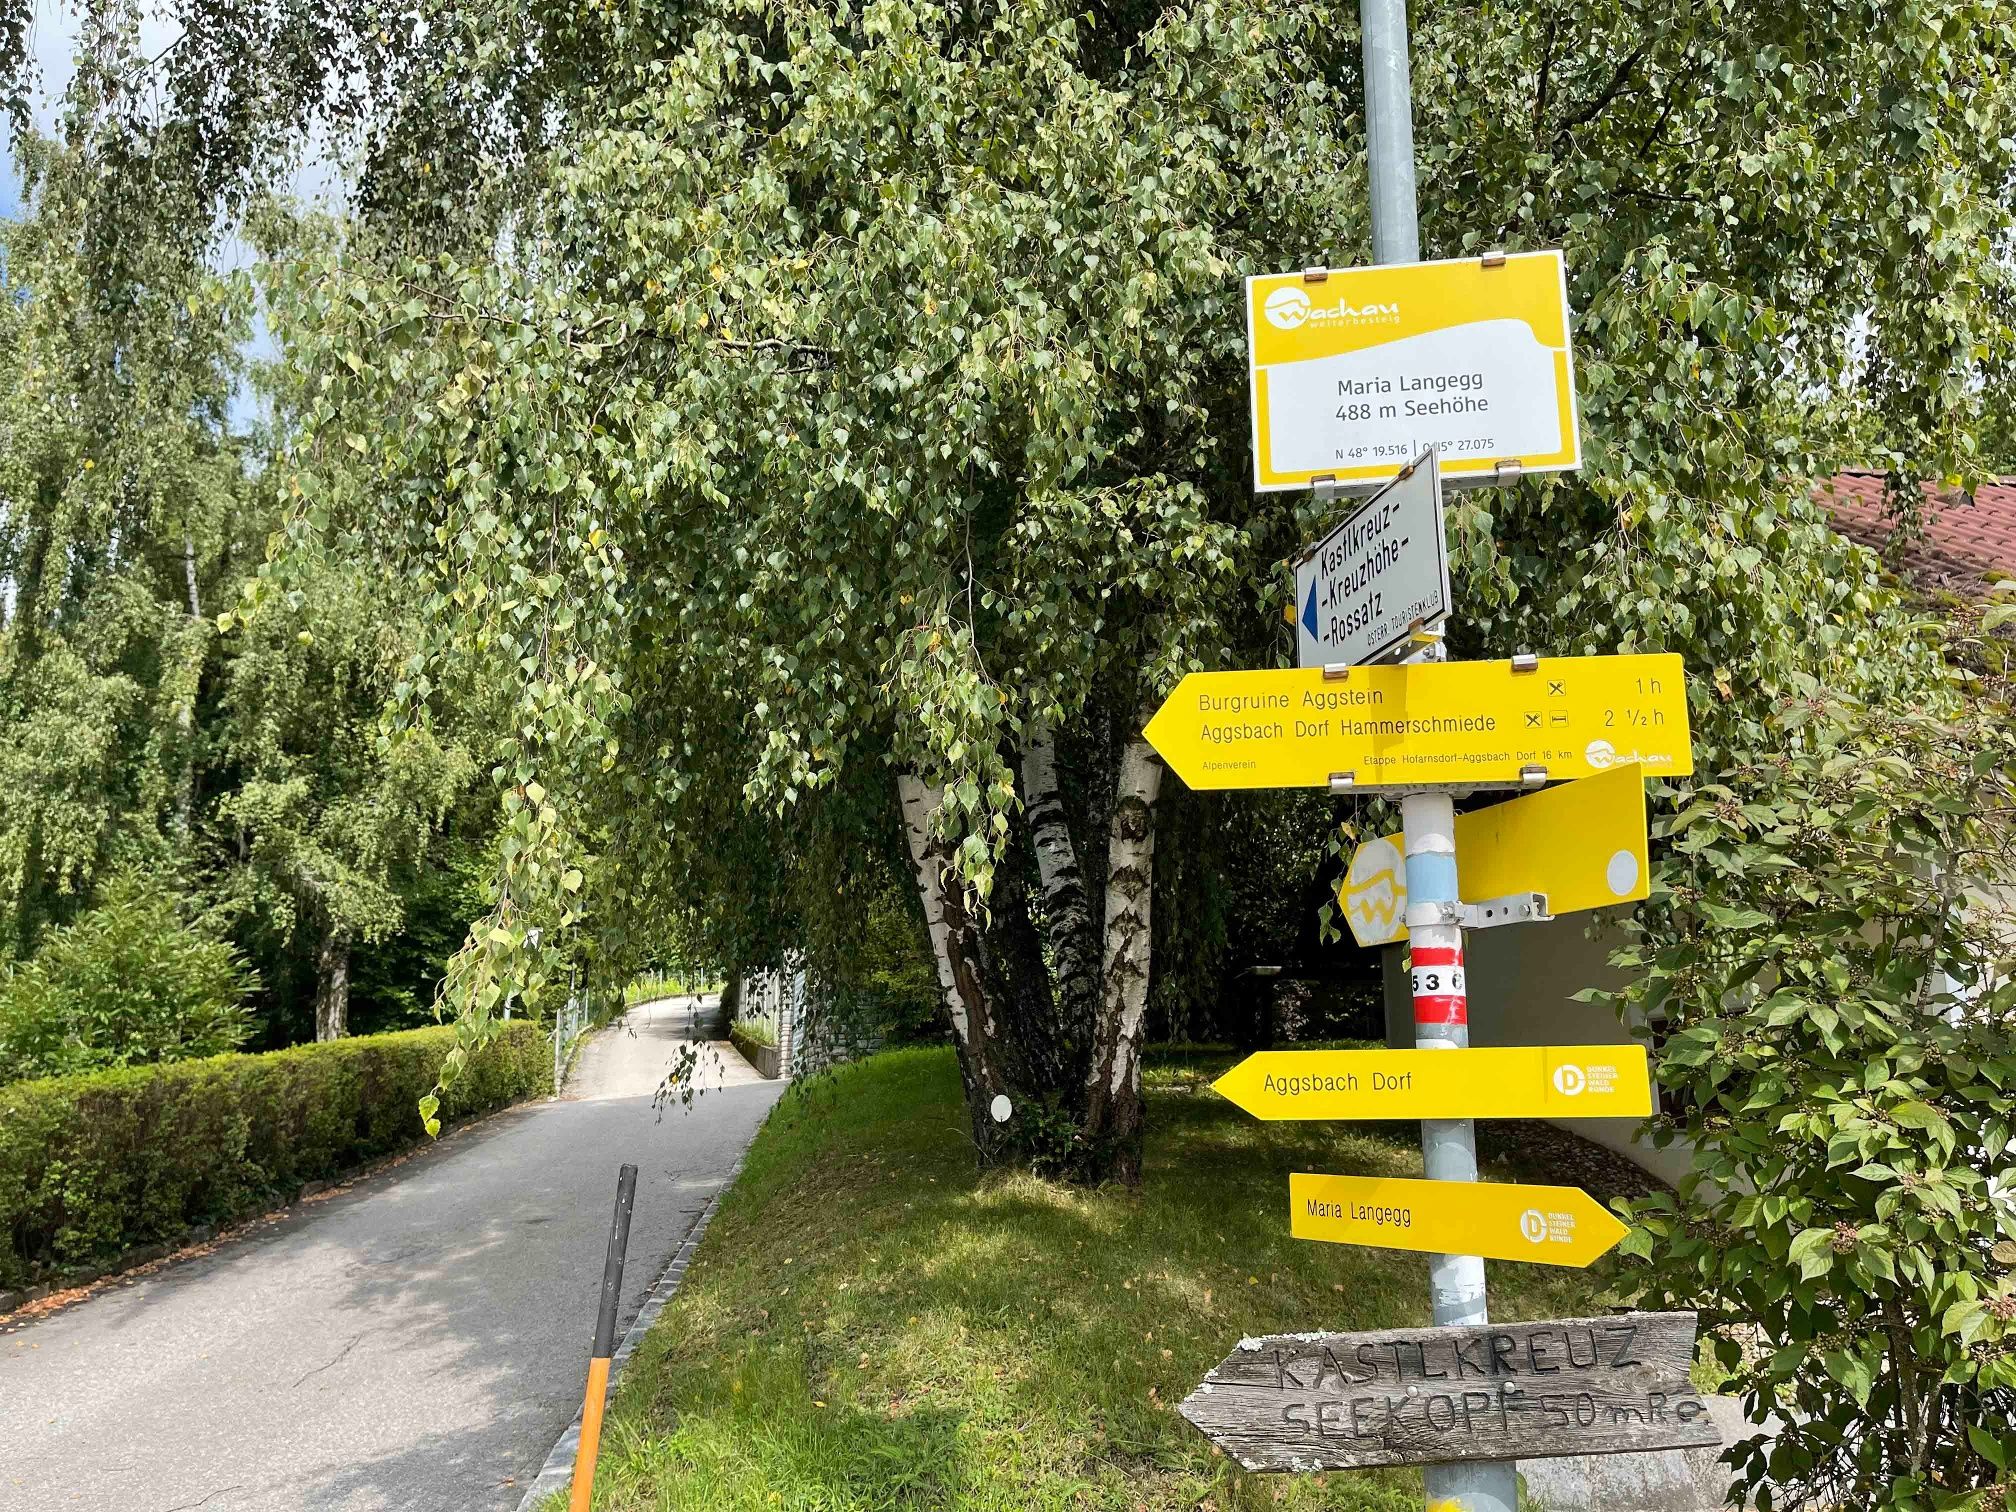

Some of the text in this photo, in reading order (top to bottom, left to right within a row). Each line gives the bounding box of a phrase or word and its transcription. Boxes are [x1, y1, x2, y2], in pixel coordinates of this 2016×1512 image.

[1338, 373, 1483, 396] Maria Langegg
[1336, 397, 1488, 421] 488 m Seehöhe
[1335, 449, 1343, 459] N
[1348, 447, 1368, 458] 48°
[1373, 445, 1407, 457] 19.516
[1458, 438, 1494, 450] 27.075
[1200, 678, 1661, 713] Burgruine Aggstein 1 h
[1202, 722, 1283, 743] Aggsbach
[1296, 720, 1329, 737] Dorf
[1341, 714, 1496, 736] Hammerschmiede
[1605, 710, 1614, 726] 2
[1654, 709, 1664, 725] h
[1202, 760, 1256, 771] Alpenverein
[1364, 755, 1396, 765] Etappe
[1516, 751, 1536, 761] Dorf
[1542, 751, 1552, 760] 16
[1558, 750, 1572, 759] km
[1264, 1072, 1411, 1096] Aggsbach Dorf
[1307, 1199, 1411, 1228] Maria Langegg
[1272, 1325, 1642, 1390] KASTLKREUZ
[1281, 1389, 1524, 1439] SEEKOPF
